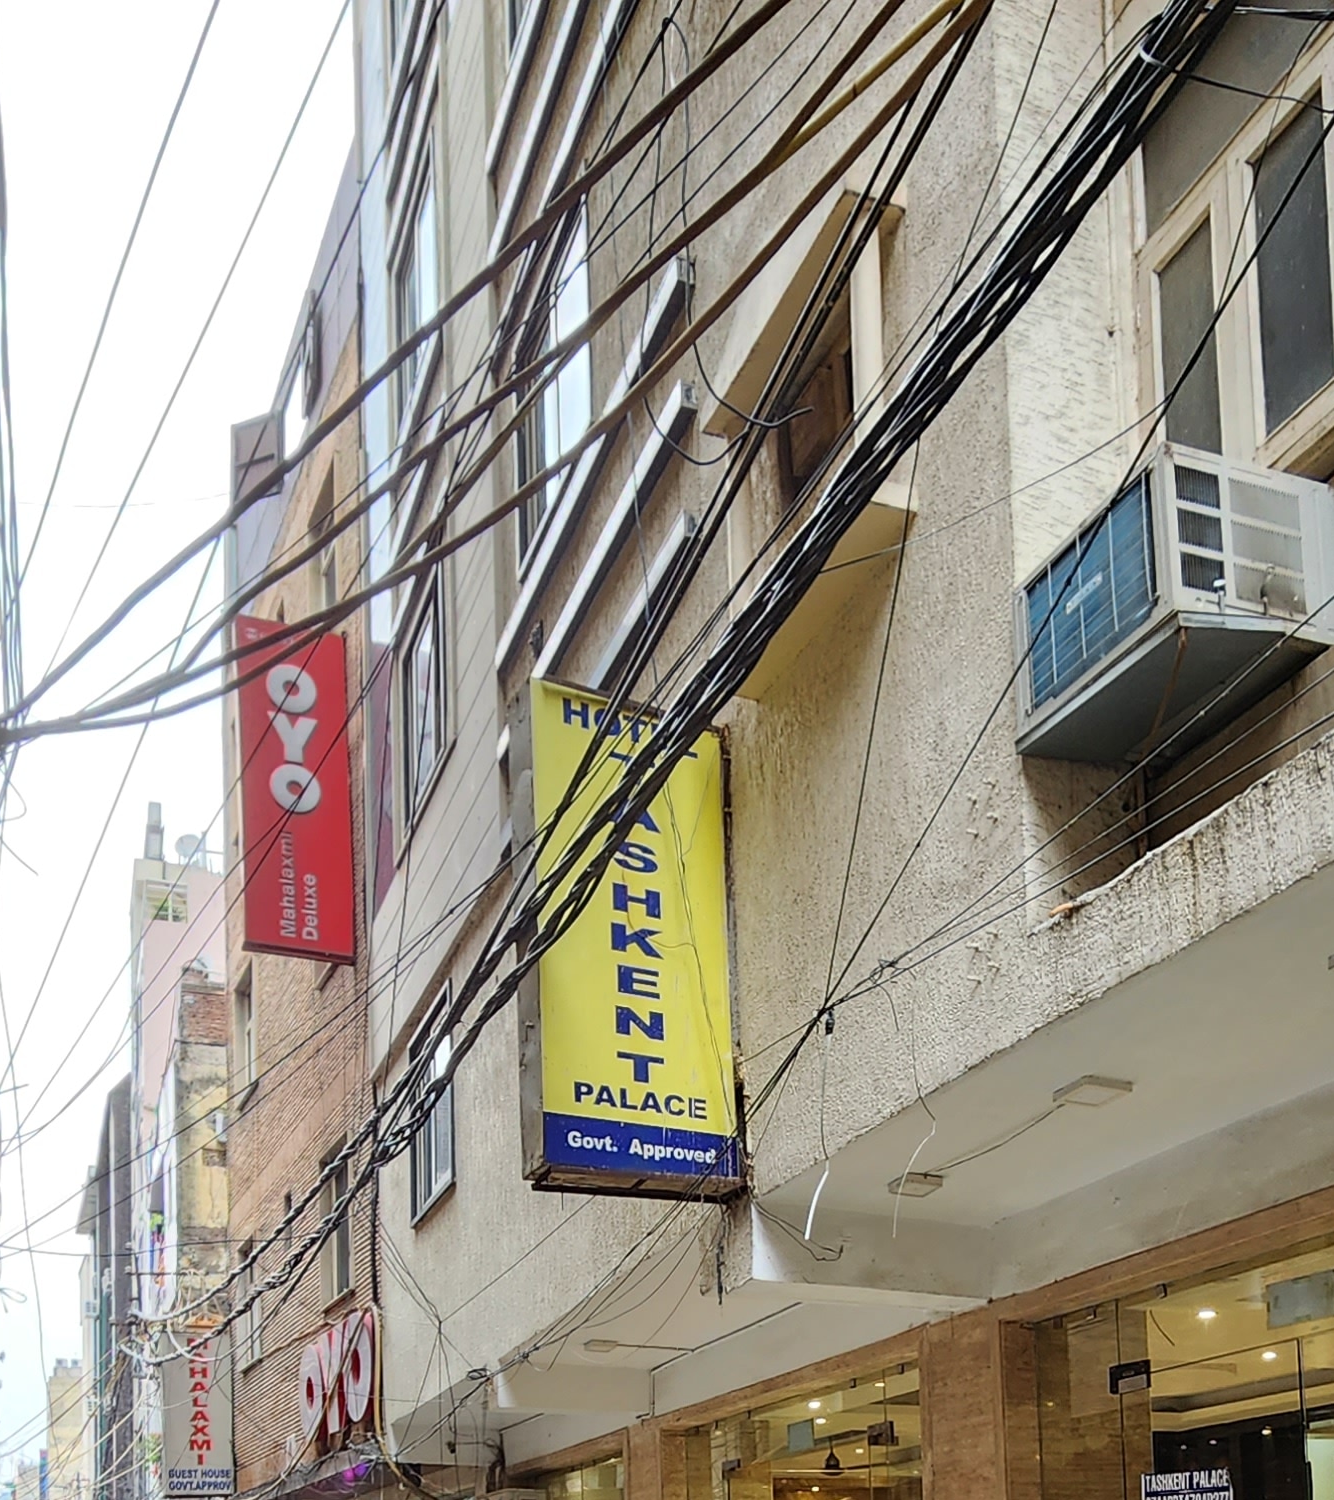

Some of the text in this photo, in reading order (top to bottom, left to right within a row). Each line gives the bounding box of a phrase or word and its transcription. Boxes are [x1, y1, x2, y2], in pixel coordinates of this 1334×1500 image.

[266, 663, 321, 814] OYO
[303, 873, 318, 941] Deluxe
[573, 1081, 707, 1120] PALACE
[567, 1131, 717, 1165] Govt. Approved
[298, 1310, 373, 1441] OYO
[169, 1468, 232, 1479] GUEST HOUSE
[1145, 1468, 1229, 1493] TASHKENT PALACE
